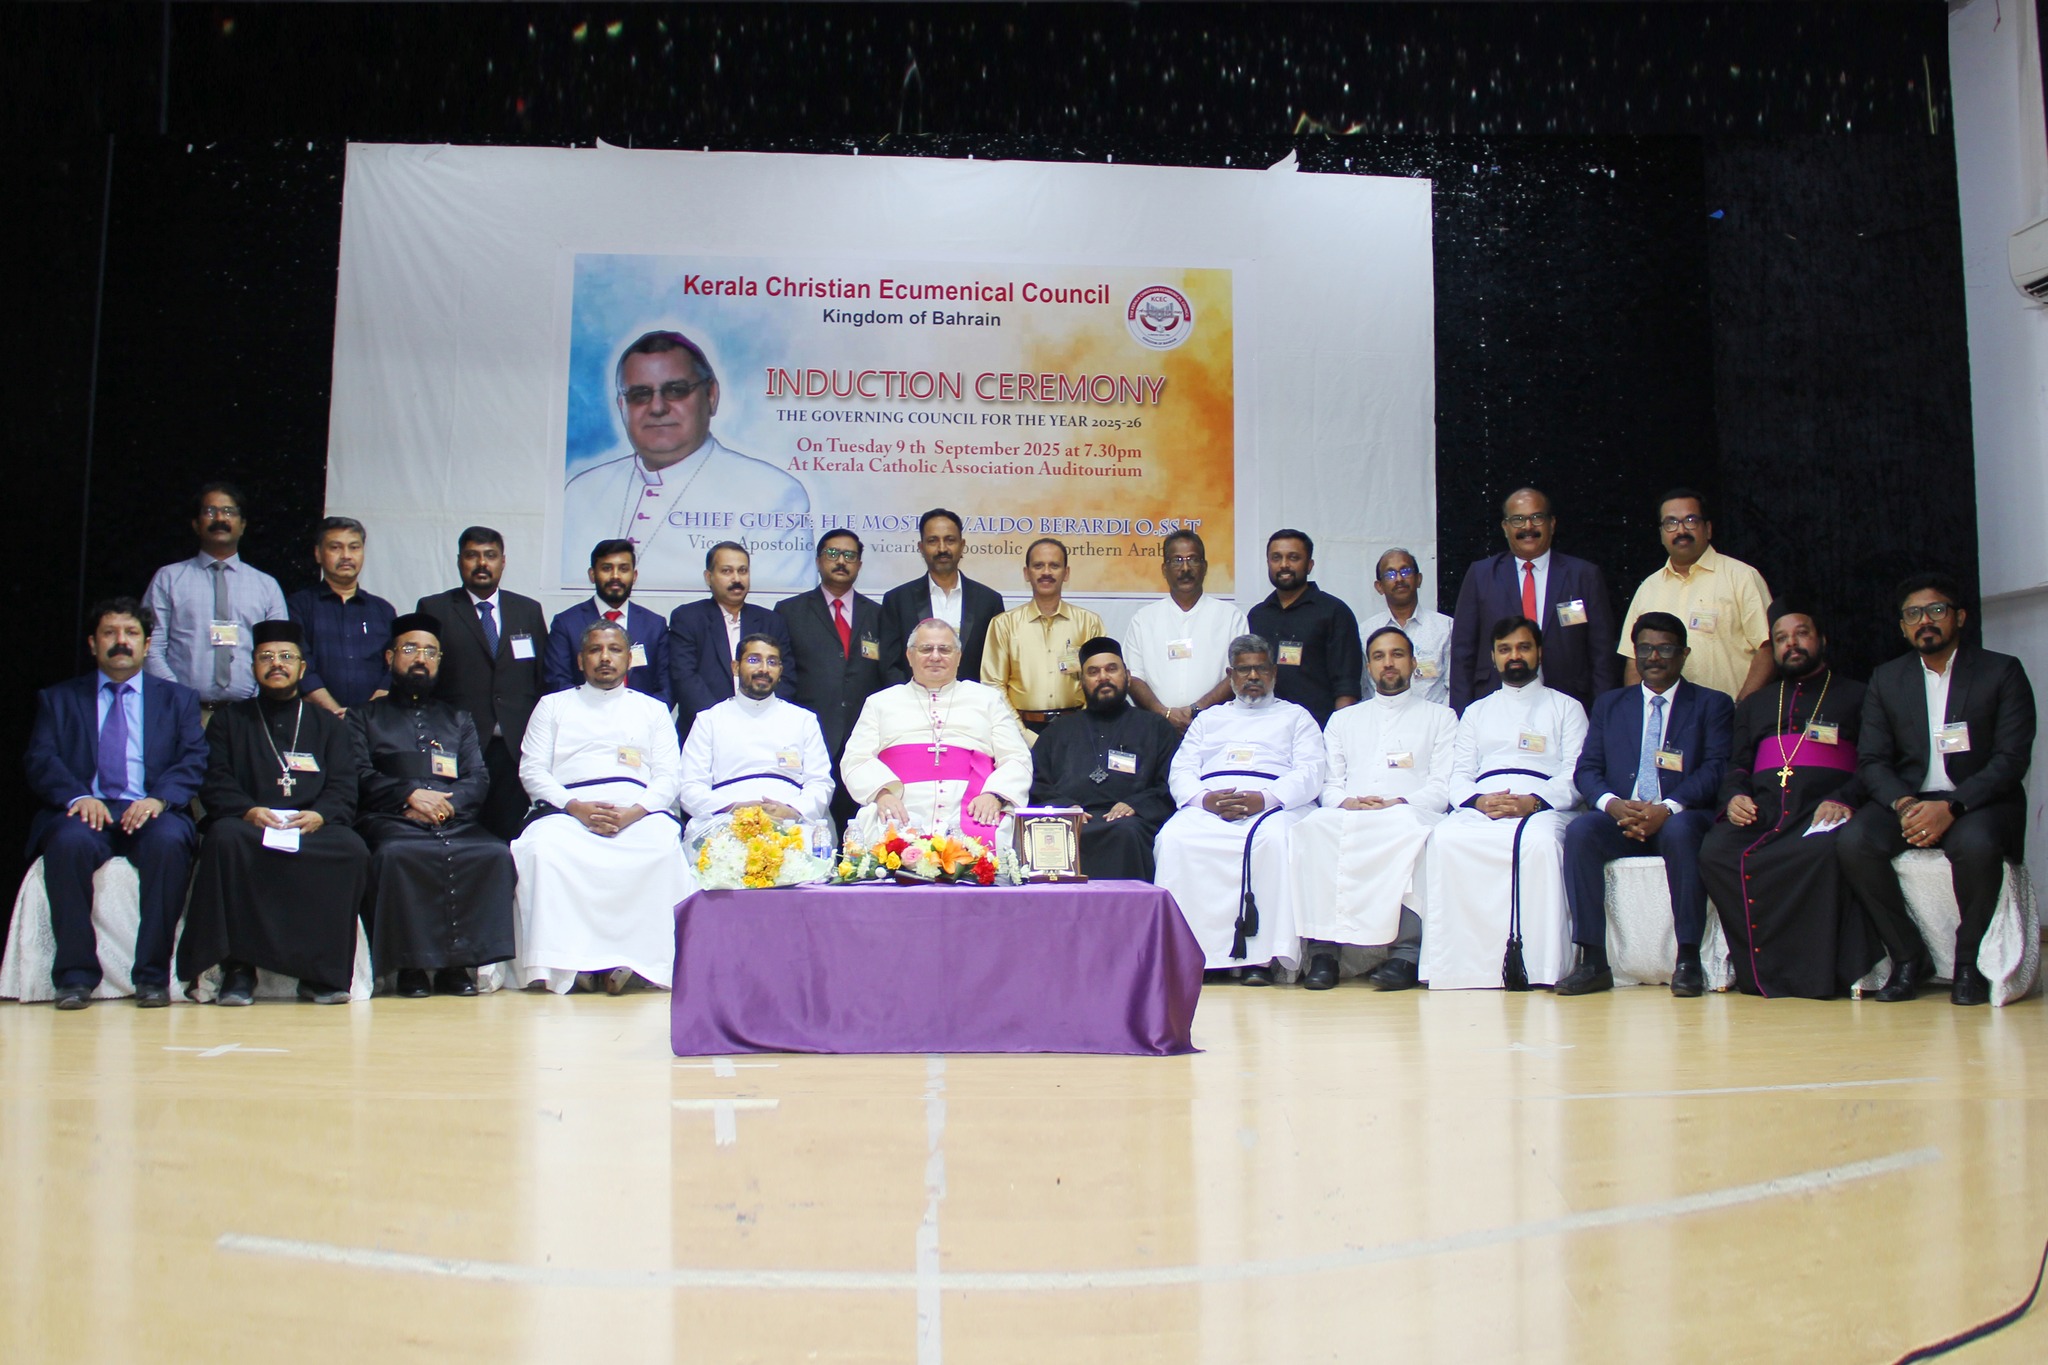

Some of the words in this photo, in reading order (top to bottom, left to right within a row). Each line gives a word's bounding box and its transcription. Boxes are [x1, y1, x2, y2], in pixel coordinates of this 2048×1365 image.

[684, 274, 757, 296] Kerala
[765, 276, 870, 298] Christian
[879, 279, 1013, 302] Ecumenical
[1022, 282, 1109, 304] Council
[823, 308, 903, 327] Kingdom
[909, 311, 927, 325] of
[932, 311, 1001, 326] Bahrain
[765, 367, 961, 399] INDUCTION
[974, 371, 1165, 403] CEREMONY
[776, 409, 808, 422] THE
[811, 410, 904, 424] GOVERNING
[908, 411, 978, 425] COUNCIL
[981, 413, 1012, 426] FOR
[1015, 414, 1046, 427] THE
[1049, 415, 1088, 428] YEAR
[1092, 417, 1142, 431] 2025-26
[797, 437, 823, 452] On
[826, 437, 892, 458] Tuesday
[896, 439, 906, 454] 9
[909, 439, 926, 454] th
[934, 439, 1020, 460] September
[1023, 442, 1060, 457] 2025
[1064, 445, 1080, 457] at
[1084, 443, 1142, 462] 7.30pm
[787, 456, 808, 471] At
[813, 456, 864, 472] Kerala
[869, 457, 938, 474] Catholic
[940, 459, 1034, 475] Association
[1038, 460, 1142, 477] Auditourium
[668, 511, 734, 527] CHIEF
[739, 512, 814, 529] GUEST:
[862, 514, 920, 531] MOST
[961, 516, 1035, 532] V.ALDO
[1039, 517, 1130, 534] BERARDI
[740, 535, 814, 556] Apostolic
[1127, 542, 1165, 557] Arab
